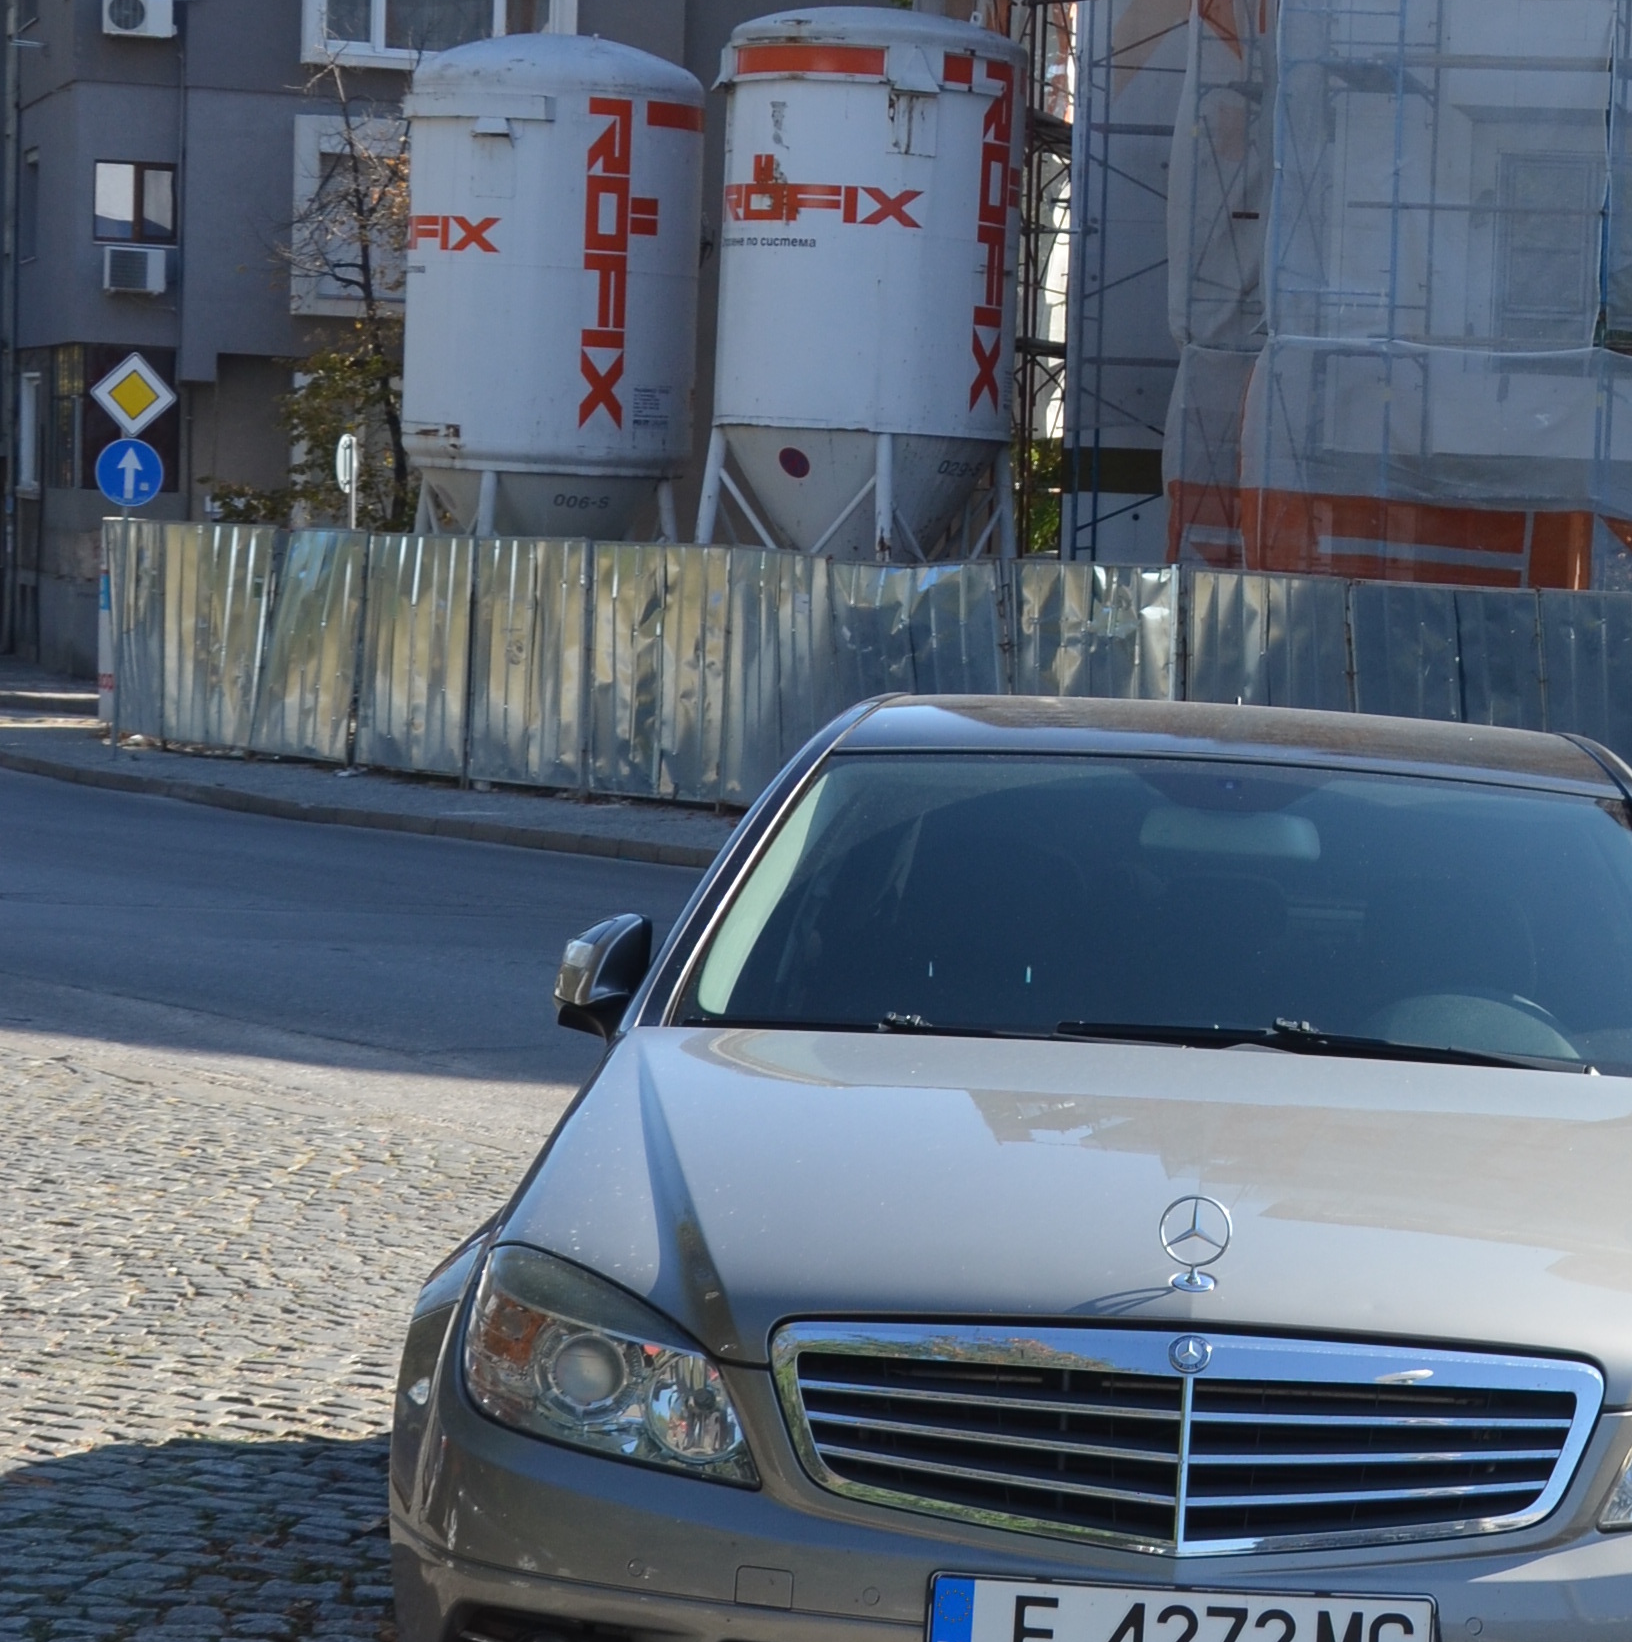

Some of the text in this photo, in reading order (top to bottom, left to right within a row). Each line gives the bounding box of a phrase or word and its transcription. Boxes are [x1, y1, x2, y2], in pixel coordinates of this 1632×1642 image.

[724, 153, 925, 229] RÖFIX
[408, 215, 502, 253] FIX
[578, 97, 659, 430] RÖFIX
[553, 493, 610, 510] 006-S
